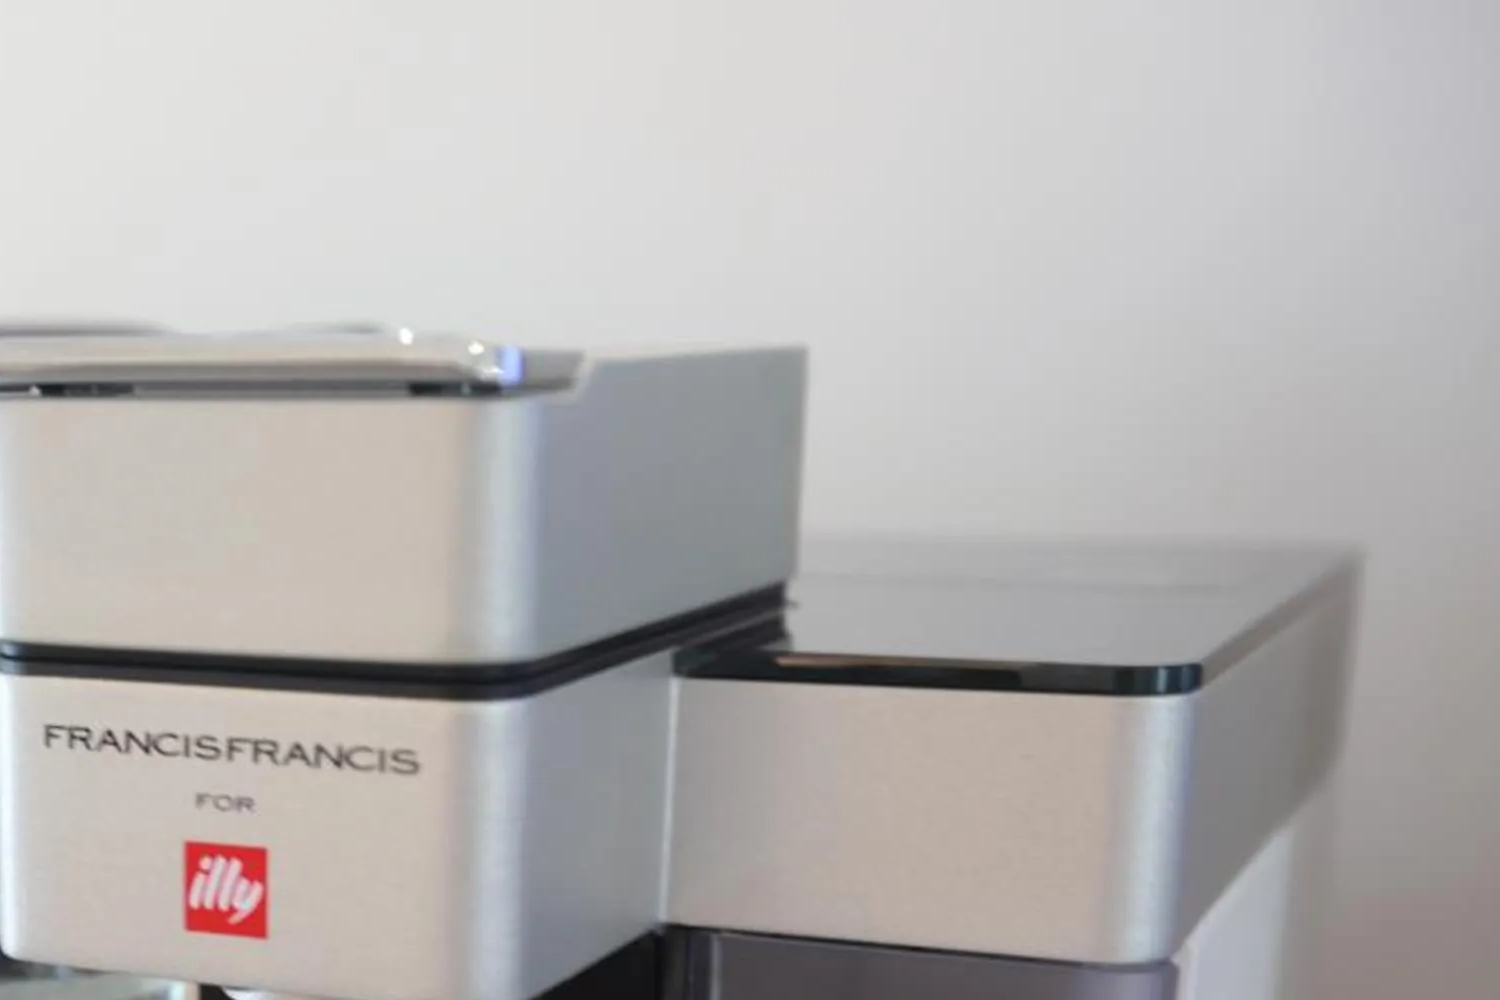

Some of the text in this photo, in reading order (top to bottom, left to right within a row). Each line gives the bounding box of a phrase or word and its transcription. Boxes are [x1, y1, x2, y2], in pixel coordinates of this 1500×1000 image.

[43, 723, 421, 776] FRANCISFRANCIS
[195, 793, 257, 814] FOR
[189, 855, 264, 924] illy
